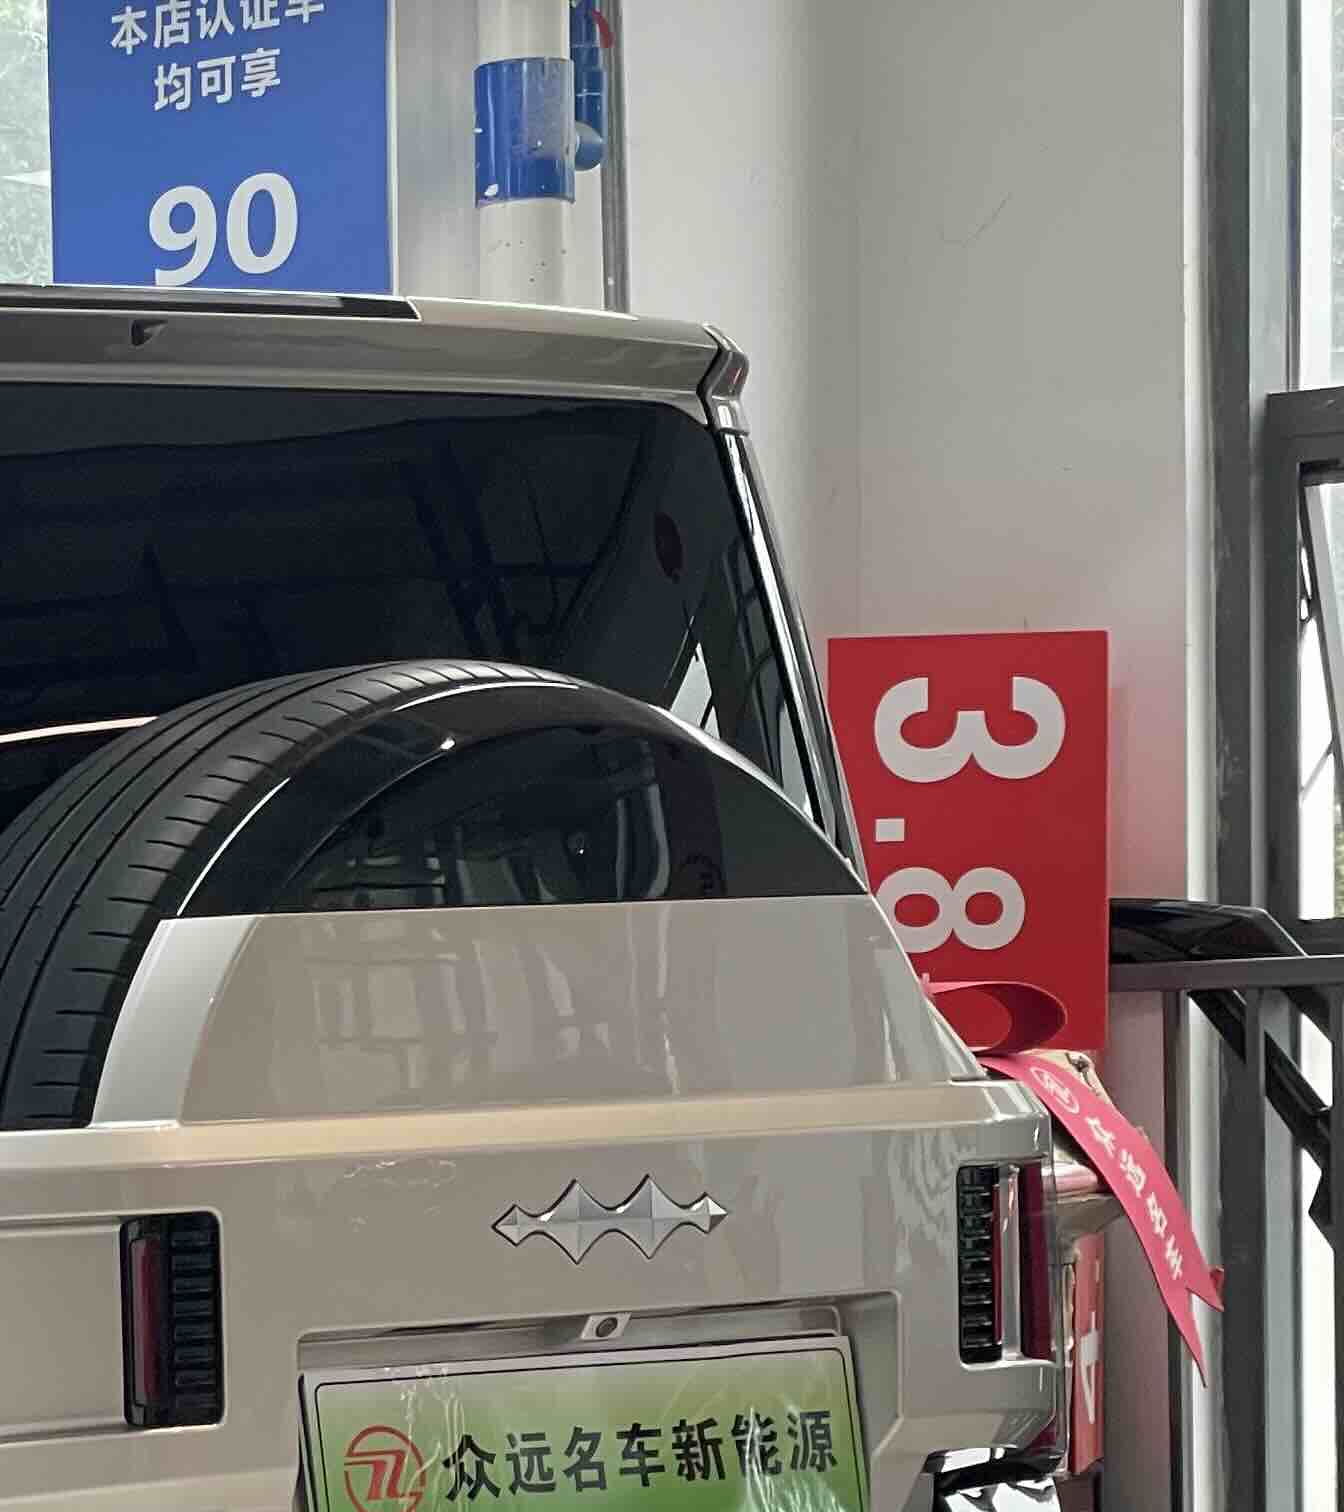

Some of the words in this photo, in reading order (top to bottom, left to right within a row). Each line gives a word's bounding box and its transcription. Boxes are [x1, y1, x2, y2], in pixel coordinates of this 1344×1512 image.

[153, 47, 282, 112] 均可享
[149, 172, 298, 287] 90
[440, 1408, 839, 1501] 众远名车新能源
